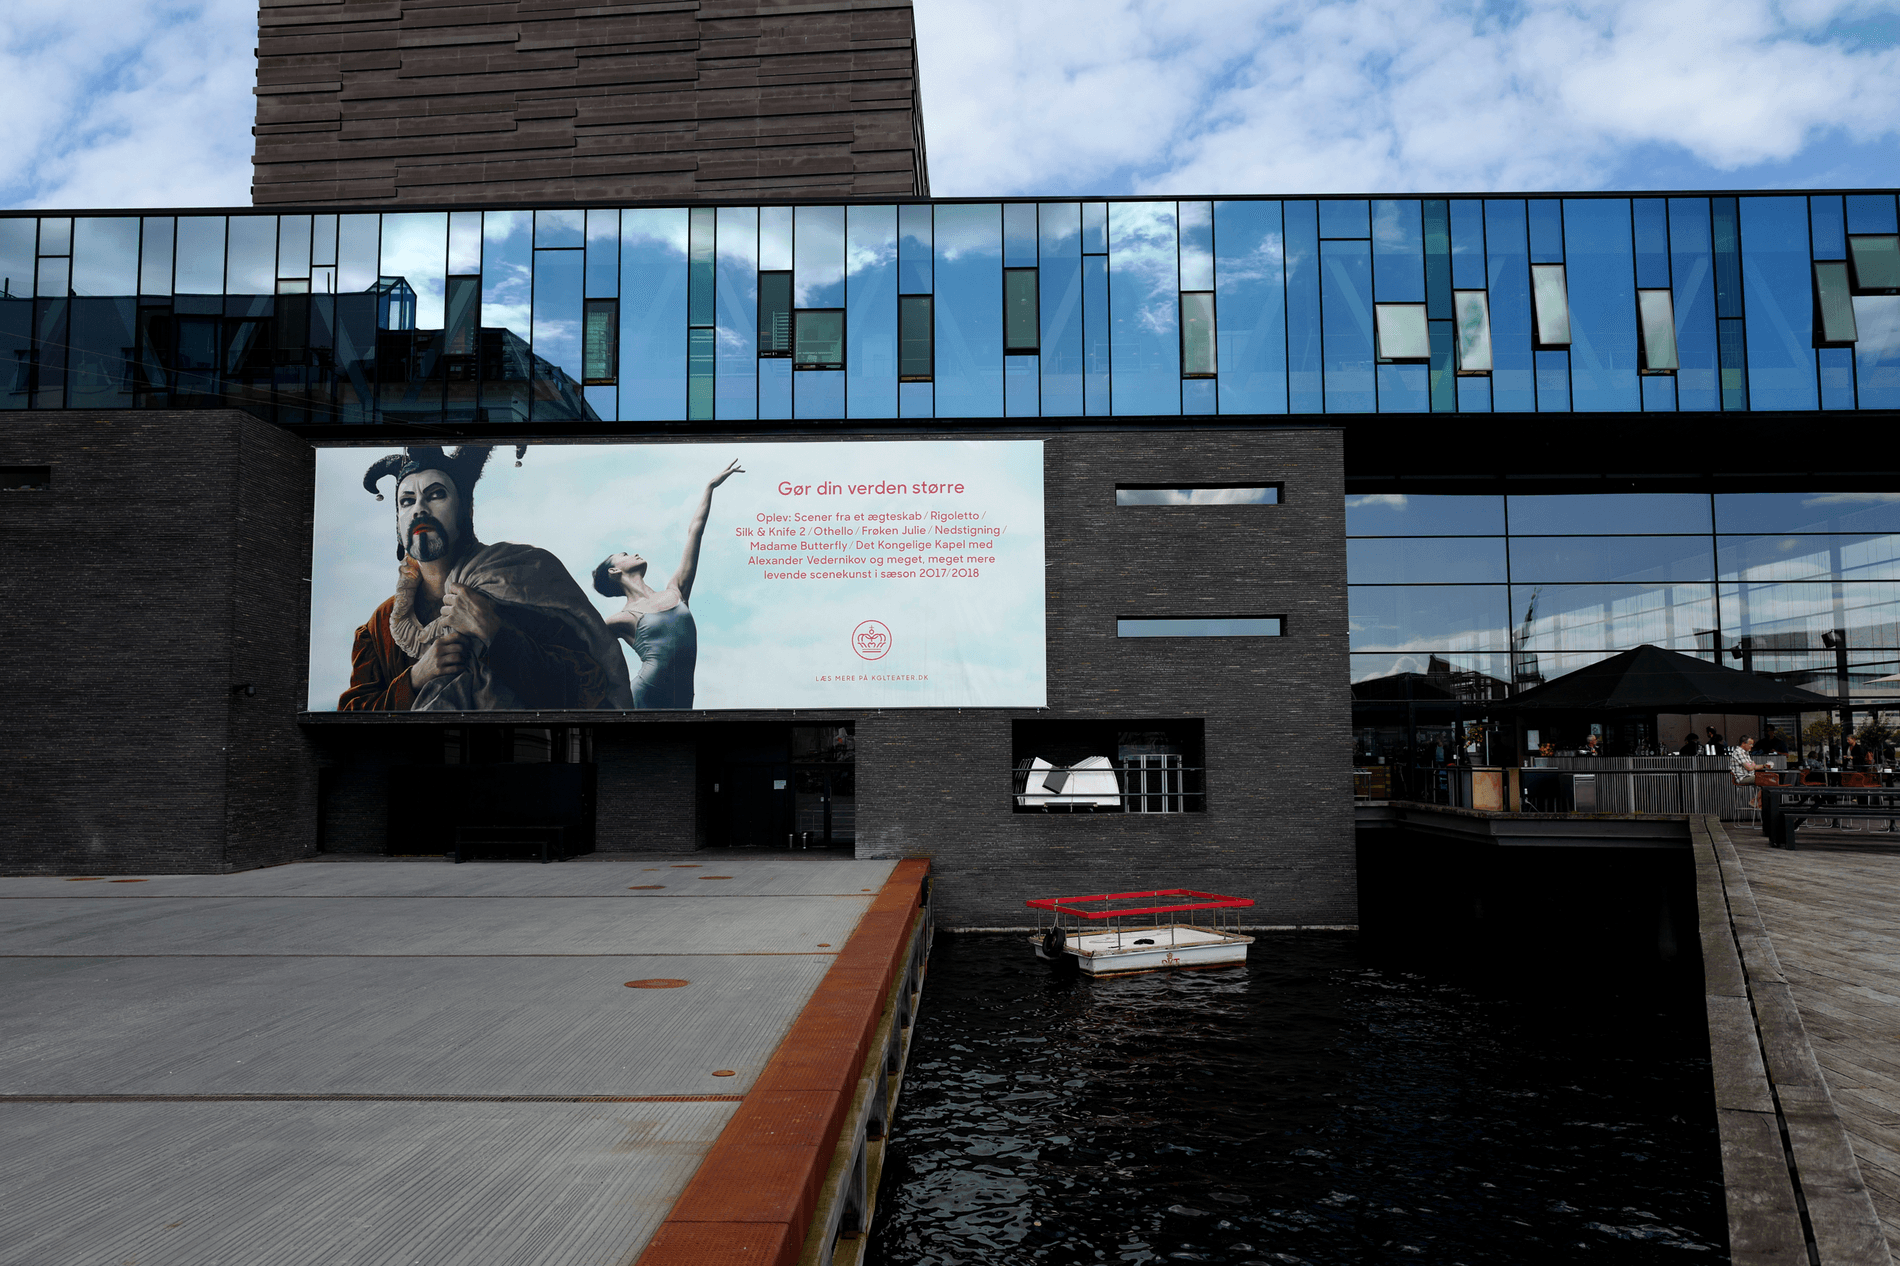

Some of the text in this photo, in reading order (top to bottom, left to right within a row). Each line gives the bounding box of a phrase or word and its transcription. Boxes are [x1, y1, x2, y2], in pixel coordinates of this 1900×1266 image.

[777, 479, 965, 497] Gør din verden større
[756, 512, 792, 525] Oplev:
[794, 512, 833, 523] Scener
[835, 511, 851, 522] fra
[853, 512, 865, 522] et
[735, 526, 754, 537] Silk
[756, 526, 766, 537] &
[768, 526, 797, 537] Knife
[799, 526, 806, 537] 2
[861, 525, 899, 536] Frøken
[750, 541, 798, 551] Madame
[855, 540, 875, 550] Det
[877, 539, 932, 552] Kongelige
[934, 539, 966, 551] Kapel
[968, 539, 993, 549] med
[748, 554, 996, 567] Alexander Vedernikov og meget, meget mere
[763, 570, 808, 580] levende
[809, 569, 872, 580] scenekunst
[880, 570, 917, 579] sæson
[919, 567, 980, 578] 2017/2018
